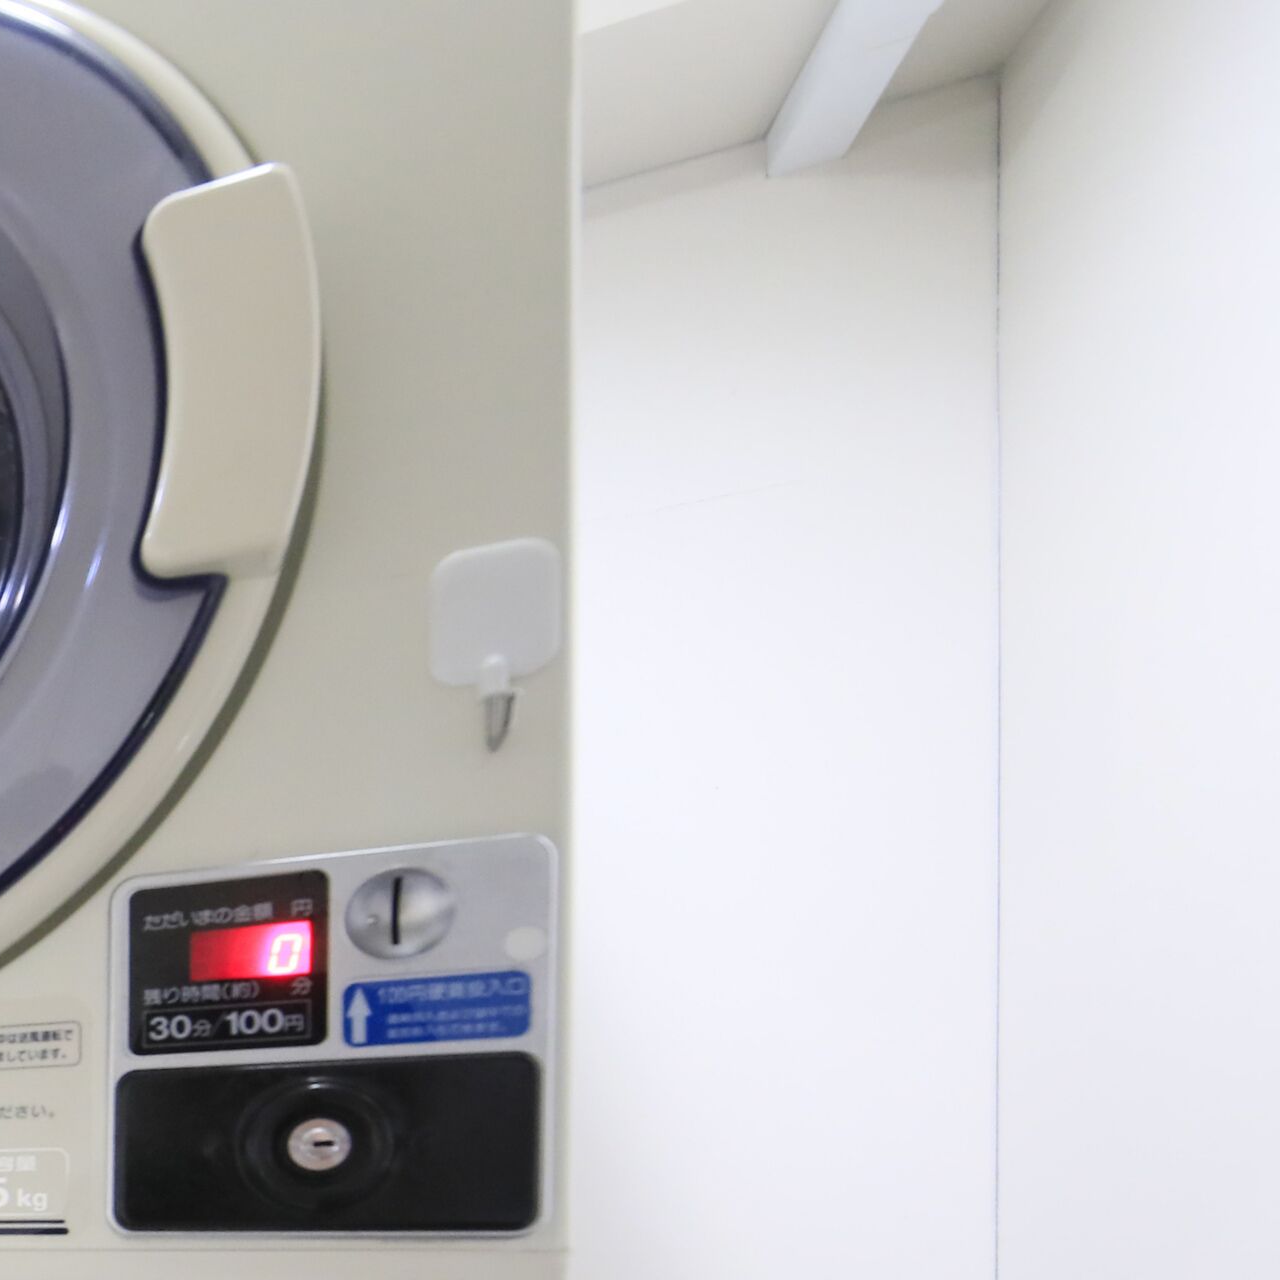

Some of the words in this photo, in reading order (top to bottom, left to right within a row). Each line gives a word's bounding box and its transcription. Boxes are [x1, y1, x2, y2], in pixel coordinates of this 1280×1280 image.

[143, 900, 273, 931] ただいまの金額
[291, 898, 314, 918] 円
[266, 932, 303, 976] 0
[291, 975, 314, 996] 分
[16, 1187, 48, 1211] kg
